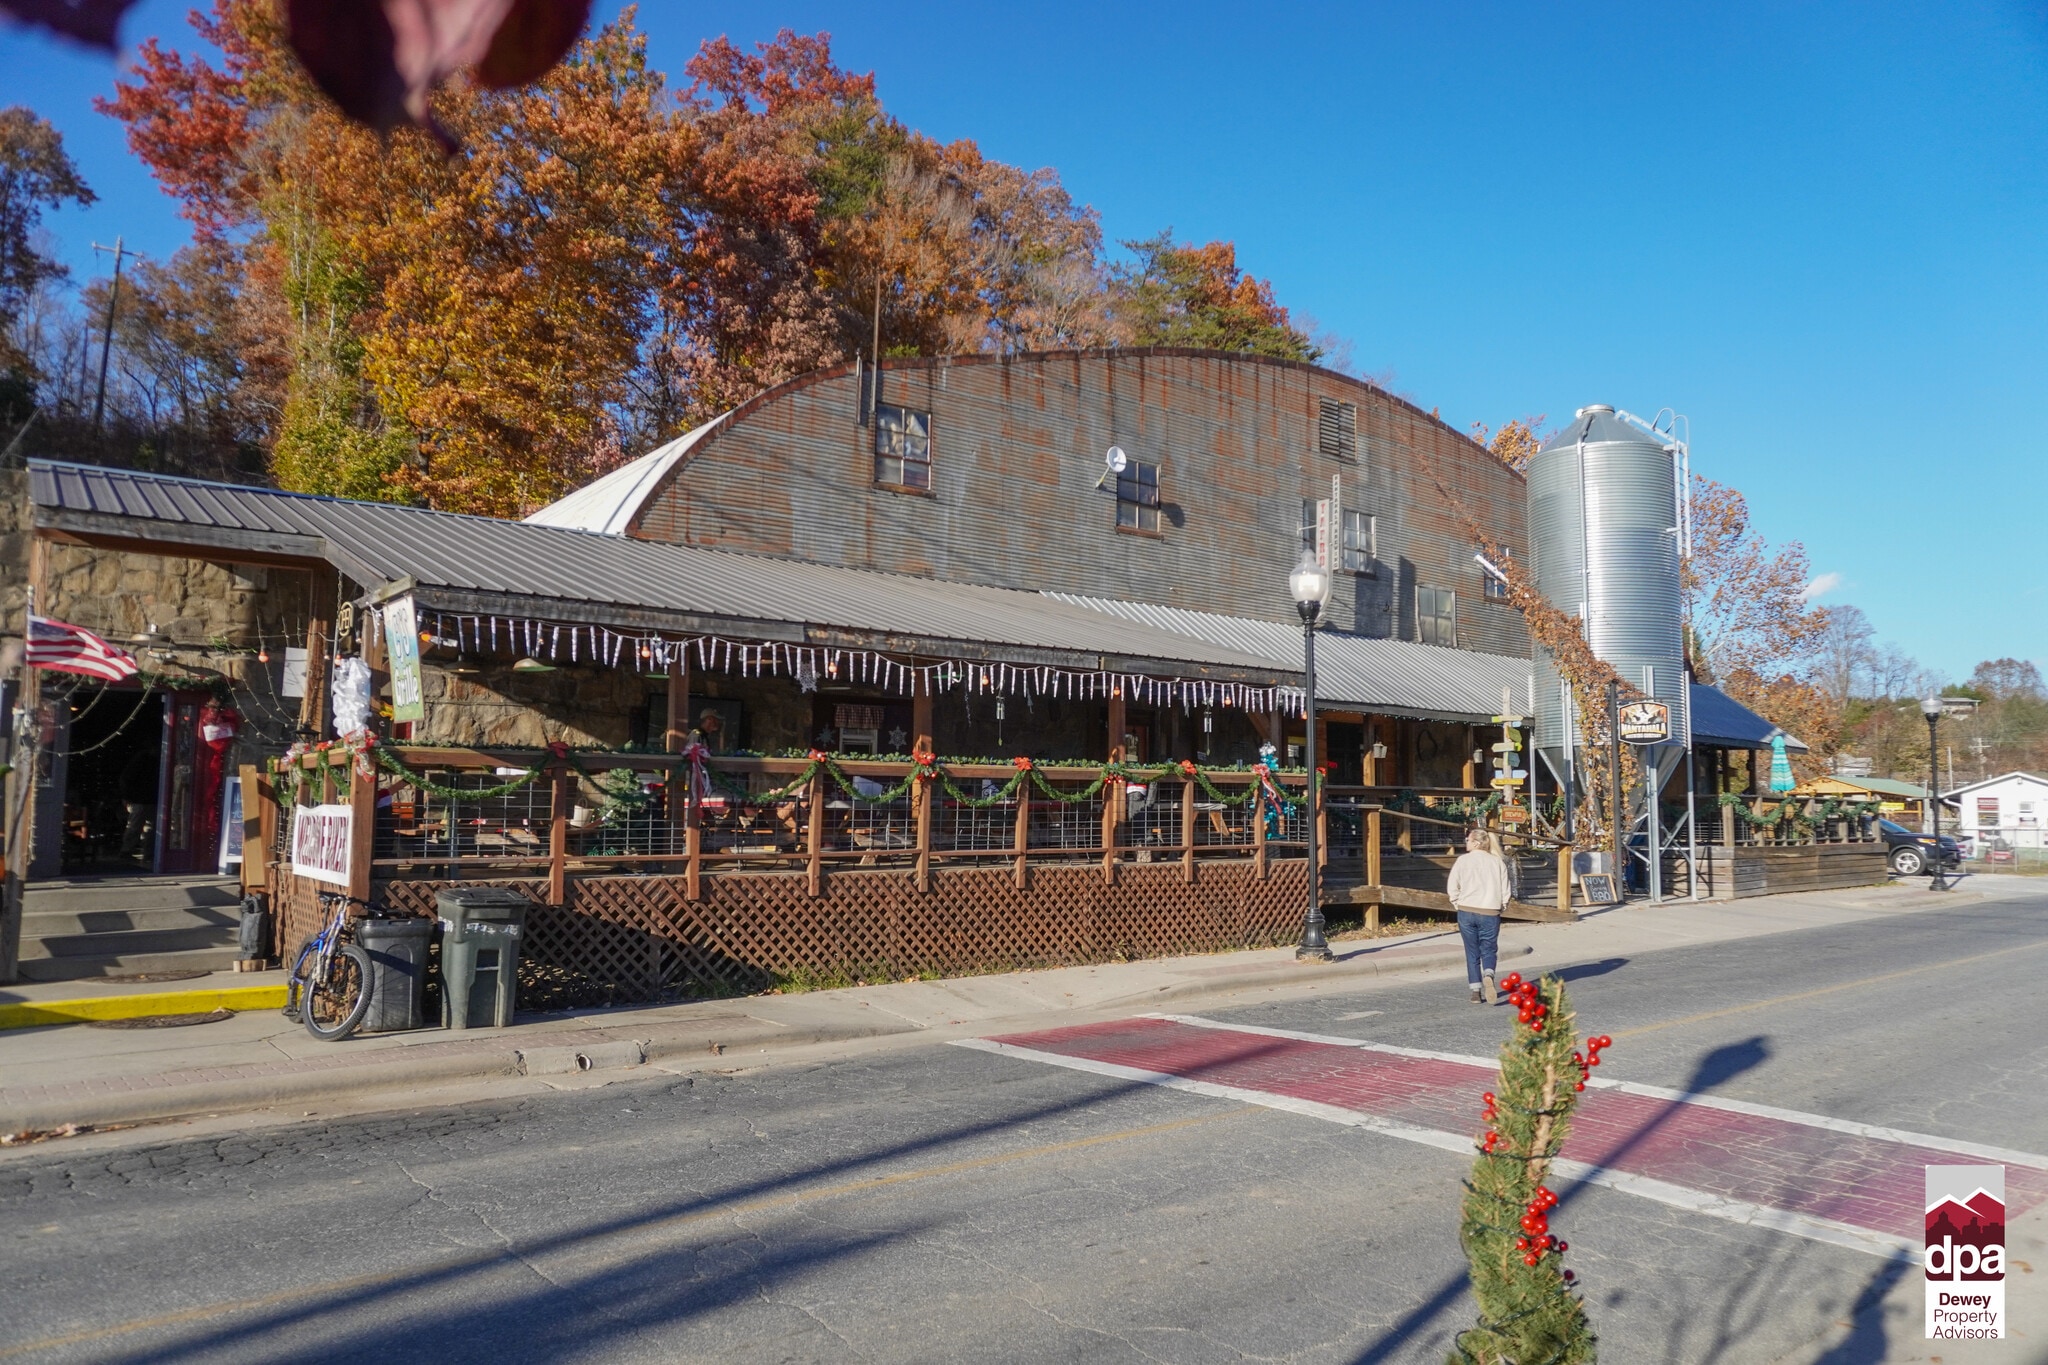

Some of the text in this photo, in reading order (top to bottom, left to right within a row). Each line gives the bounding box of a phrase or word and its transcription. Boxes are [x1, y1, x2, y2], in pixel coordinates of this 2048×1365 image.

[1621, 722, 1667, 736] NANTAHALA
[1585, 876, 1606, 885] NOW
[1592, 891, 1611, 901] BBQ
